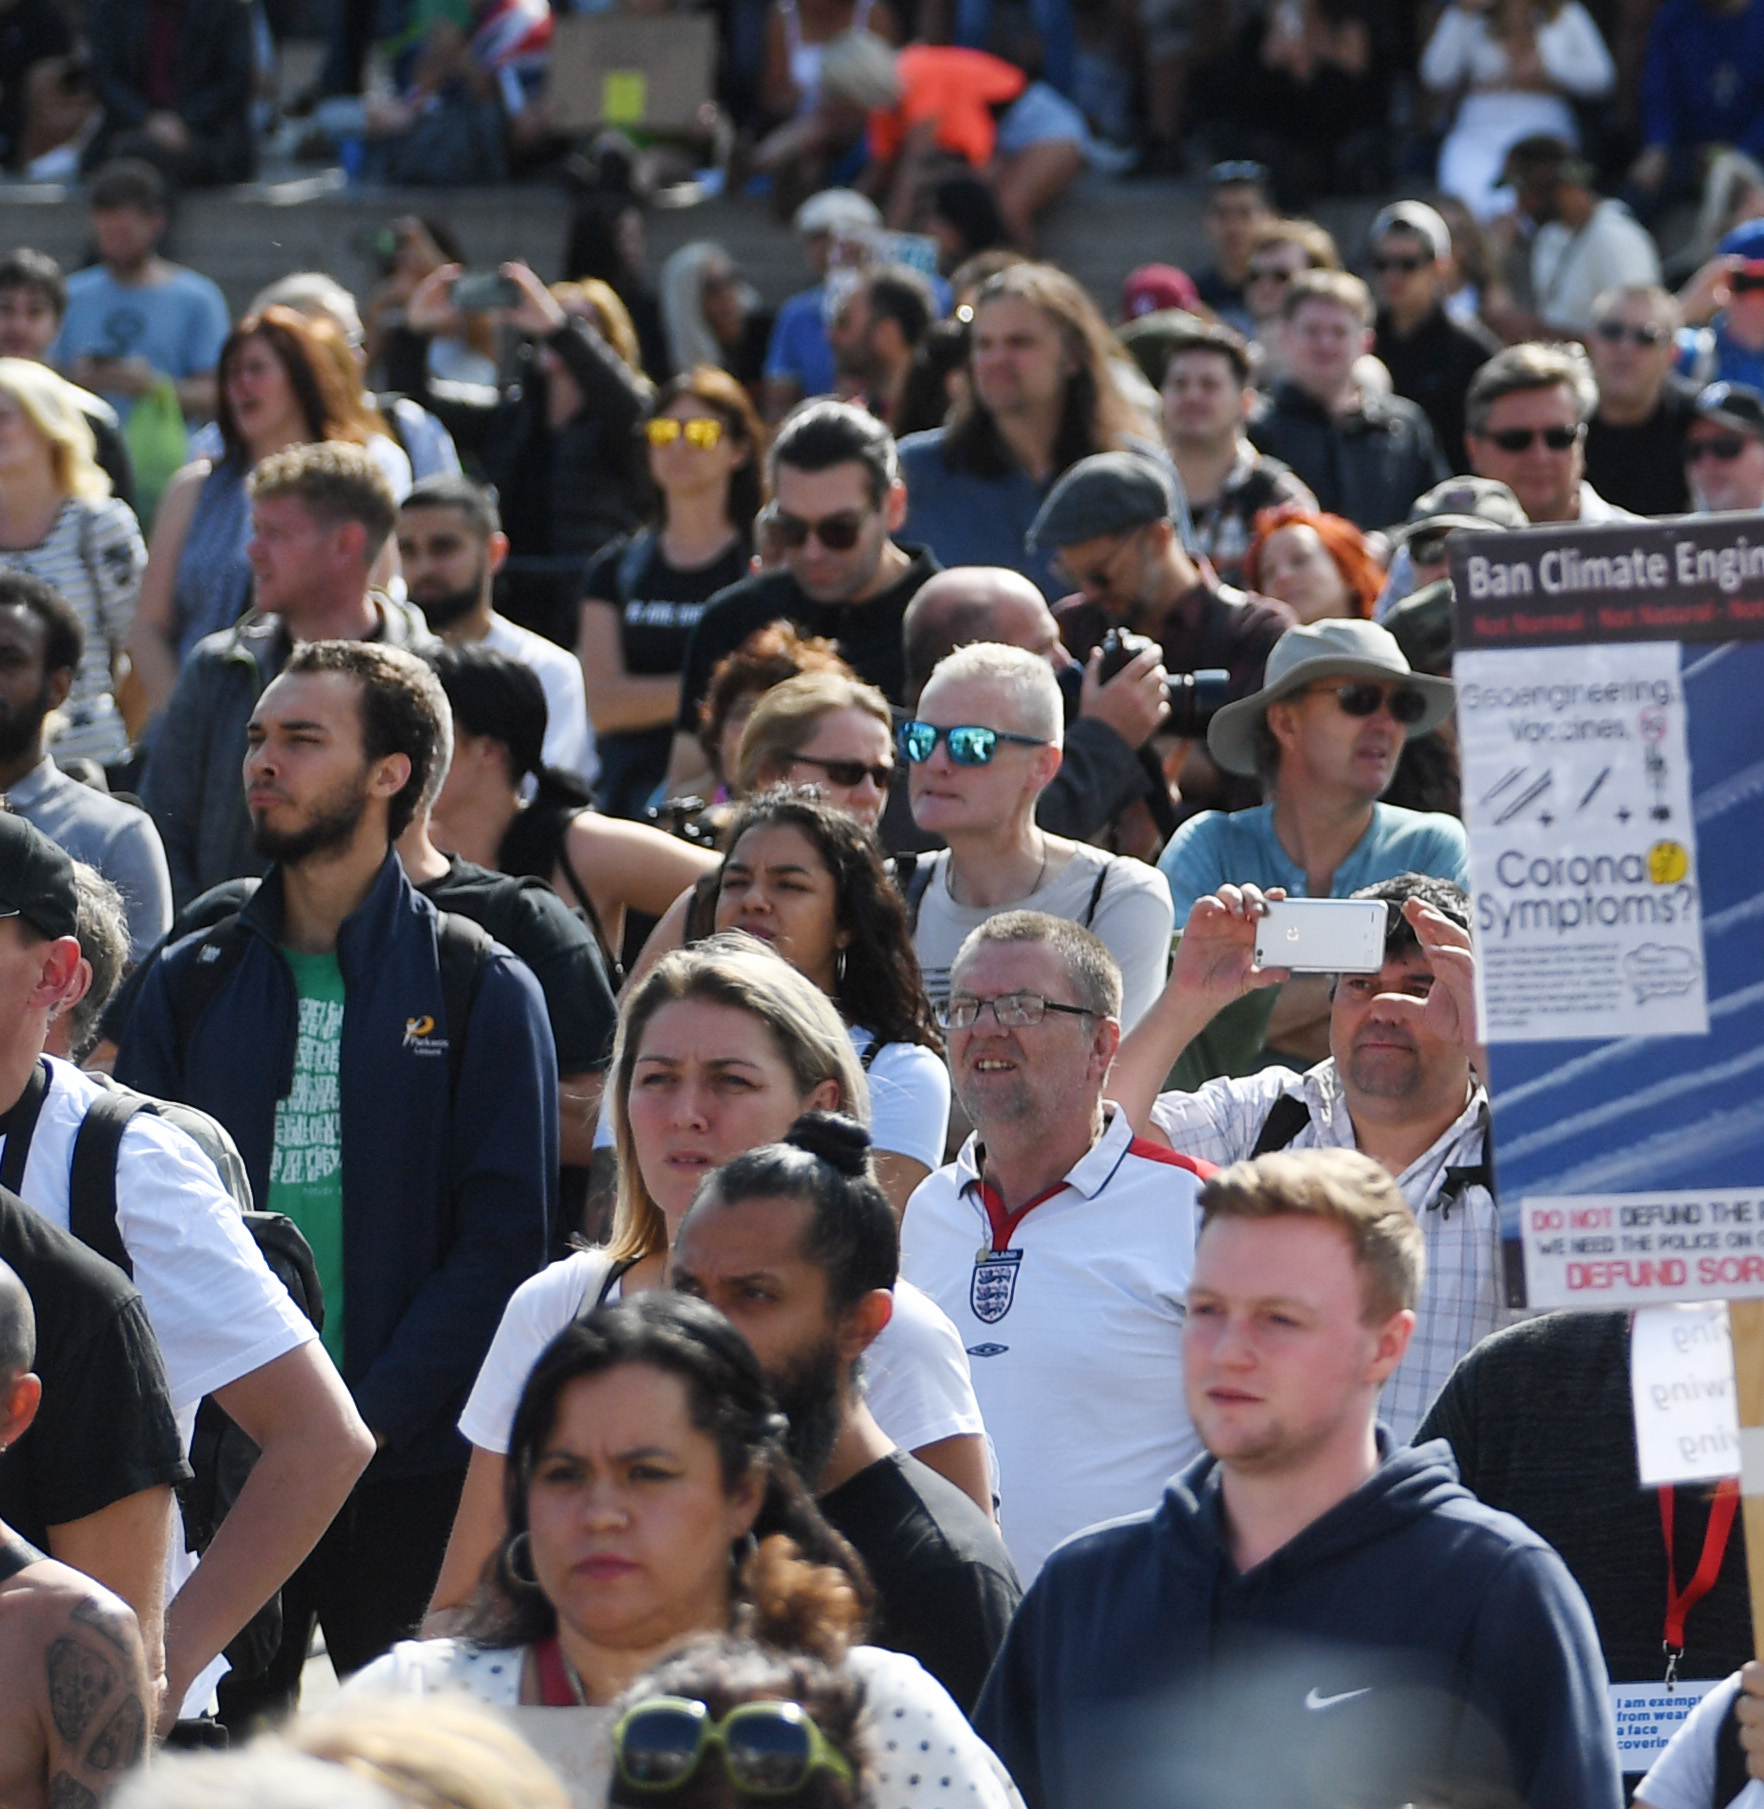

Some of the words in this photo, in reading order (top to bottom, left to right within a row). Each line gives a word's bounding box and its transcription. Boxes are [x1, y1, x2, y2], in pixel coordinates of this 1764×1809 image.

[1467, 554, 1533, 599] Ban
[1538, 547, 1669, 594] Climate
[1496, 850, 1646, 888] Corona
[1478, 884, 1695, 937] Symptoms?
[1531, 1207, 1563, 1231] DO
[1569, 1205, 1615, 1229] NOT
[1619, 1201, 1701, 1227] DEFUND
[1710, 1198, 1752, 1223] THE
[1539, 1236, 1566, 1255] WE
[1570, 1234, 1615, 1255] NEED
[1620, 1232, 1654, 1252] THE
[1658, 1229, 1720, 1250] POLICE
[1725, 1228, 1753, 1248] ON
[1565, 1258, 1688, 1290] DEFUND
[1616, 1712, 1651, 1722] from
[1624, 1699, 1646, 1709] am
[1616, 1727, 1625, 1736] a
[1627, 1725, 1659, 1735] face
[1616, 1737, 1669, 1750] coverin
